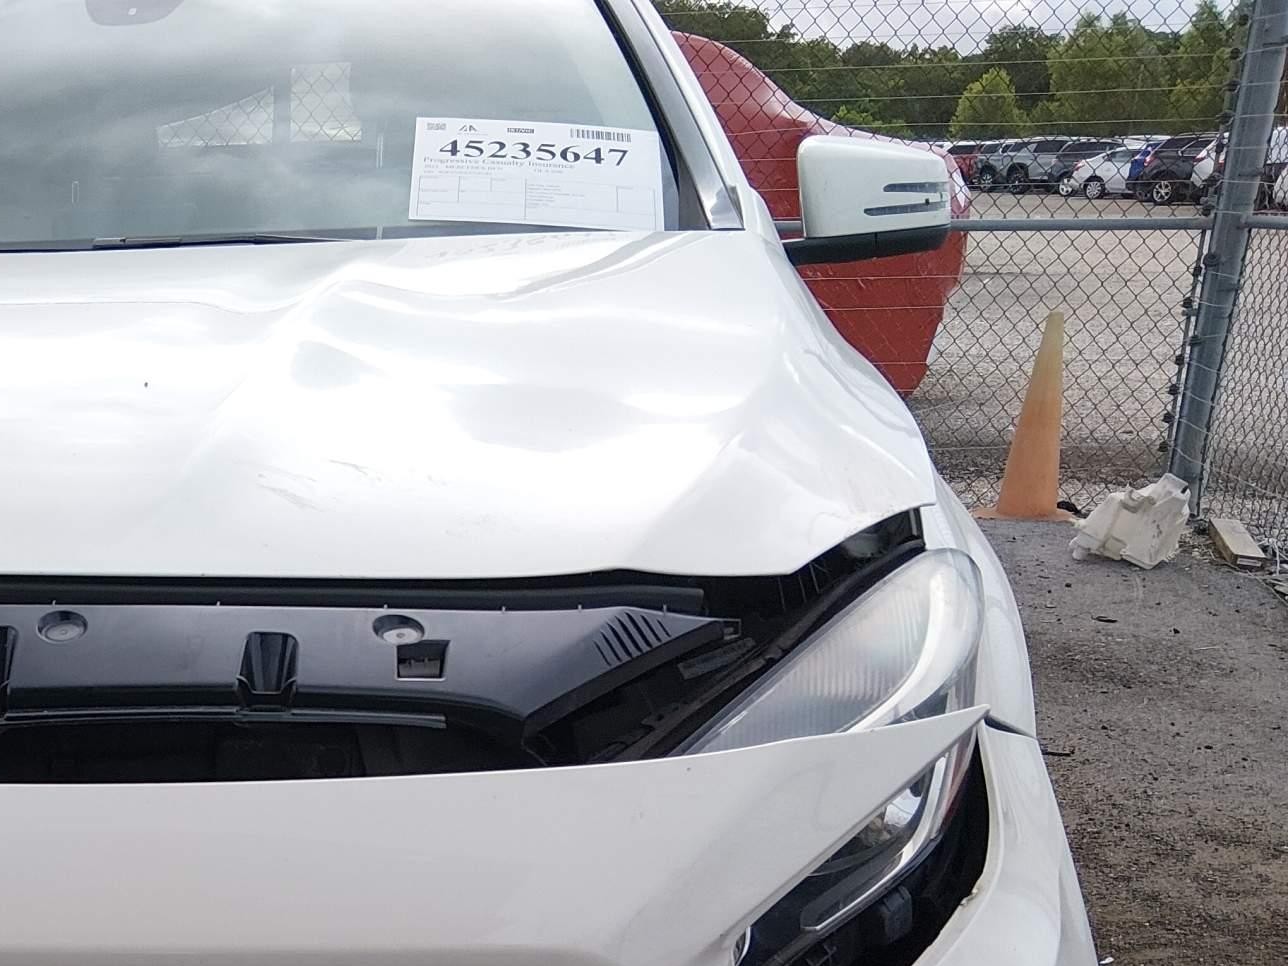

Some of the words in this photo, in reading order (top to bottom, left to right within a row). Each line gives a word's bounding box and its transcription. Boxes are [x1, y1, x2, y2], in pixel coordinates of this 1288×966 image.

[423, 156, 480, 165] Progressive
[481, 159, 525, 167] Casualty
[528, 161, 575, 169] Insurance
[439, 139, 629, 166] 45235647
